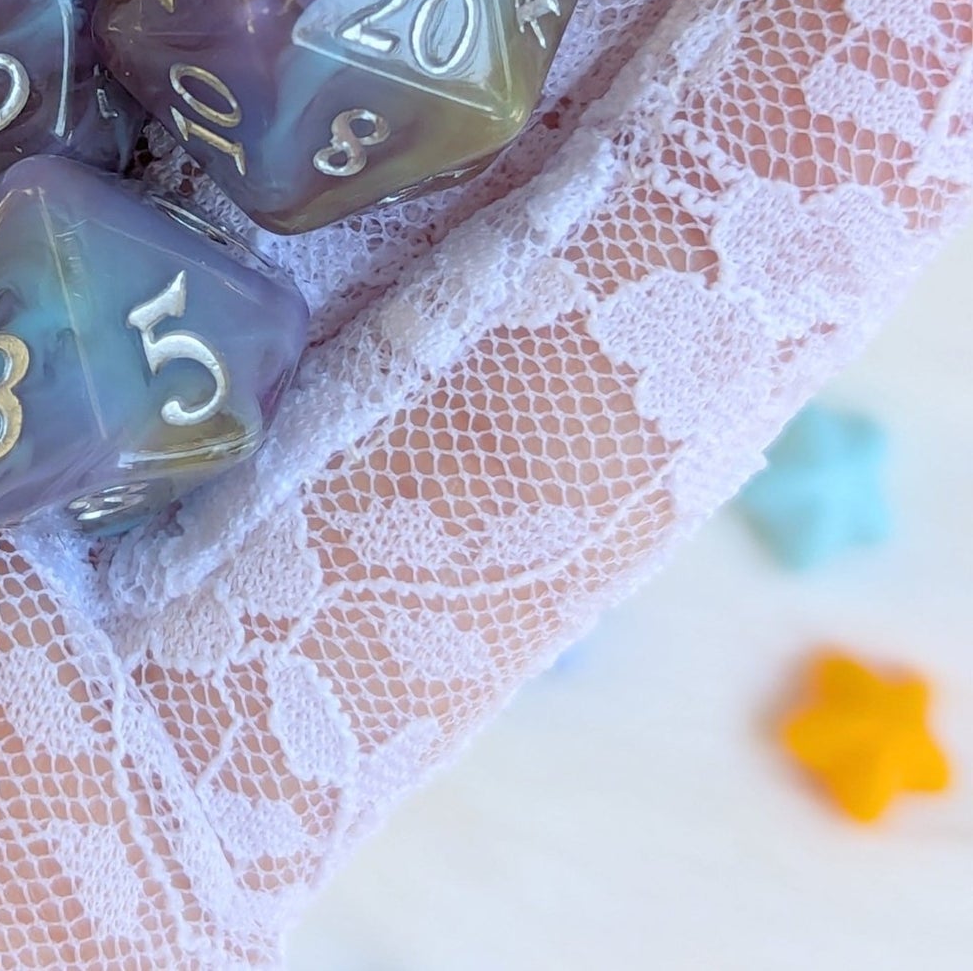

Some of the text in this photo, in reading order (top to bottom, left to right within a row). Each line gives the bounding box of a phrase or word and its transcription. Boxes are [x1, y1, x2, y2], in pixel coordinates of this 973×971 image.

[169, 63, 244, 176] 10
[313, 108, 391, 177] 8
[127, 270, 227, 426] 5
